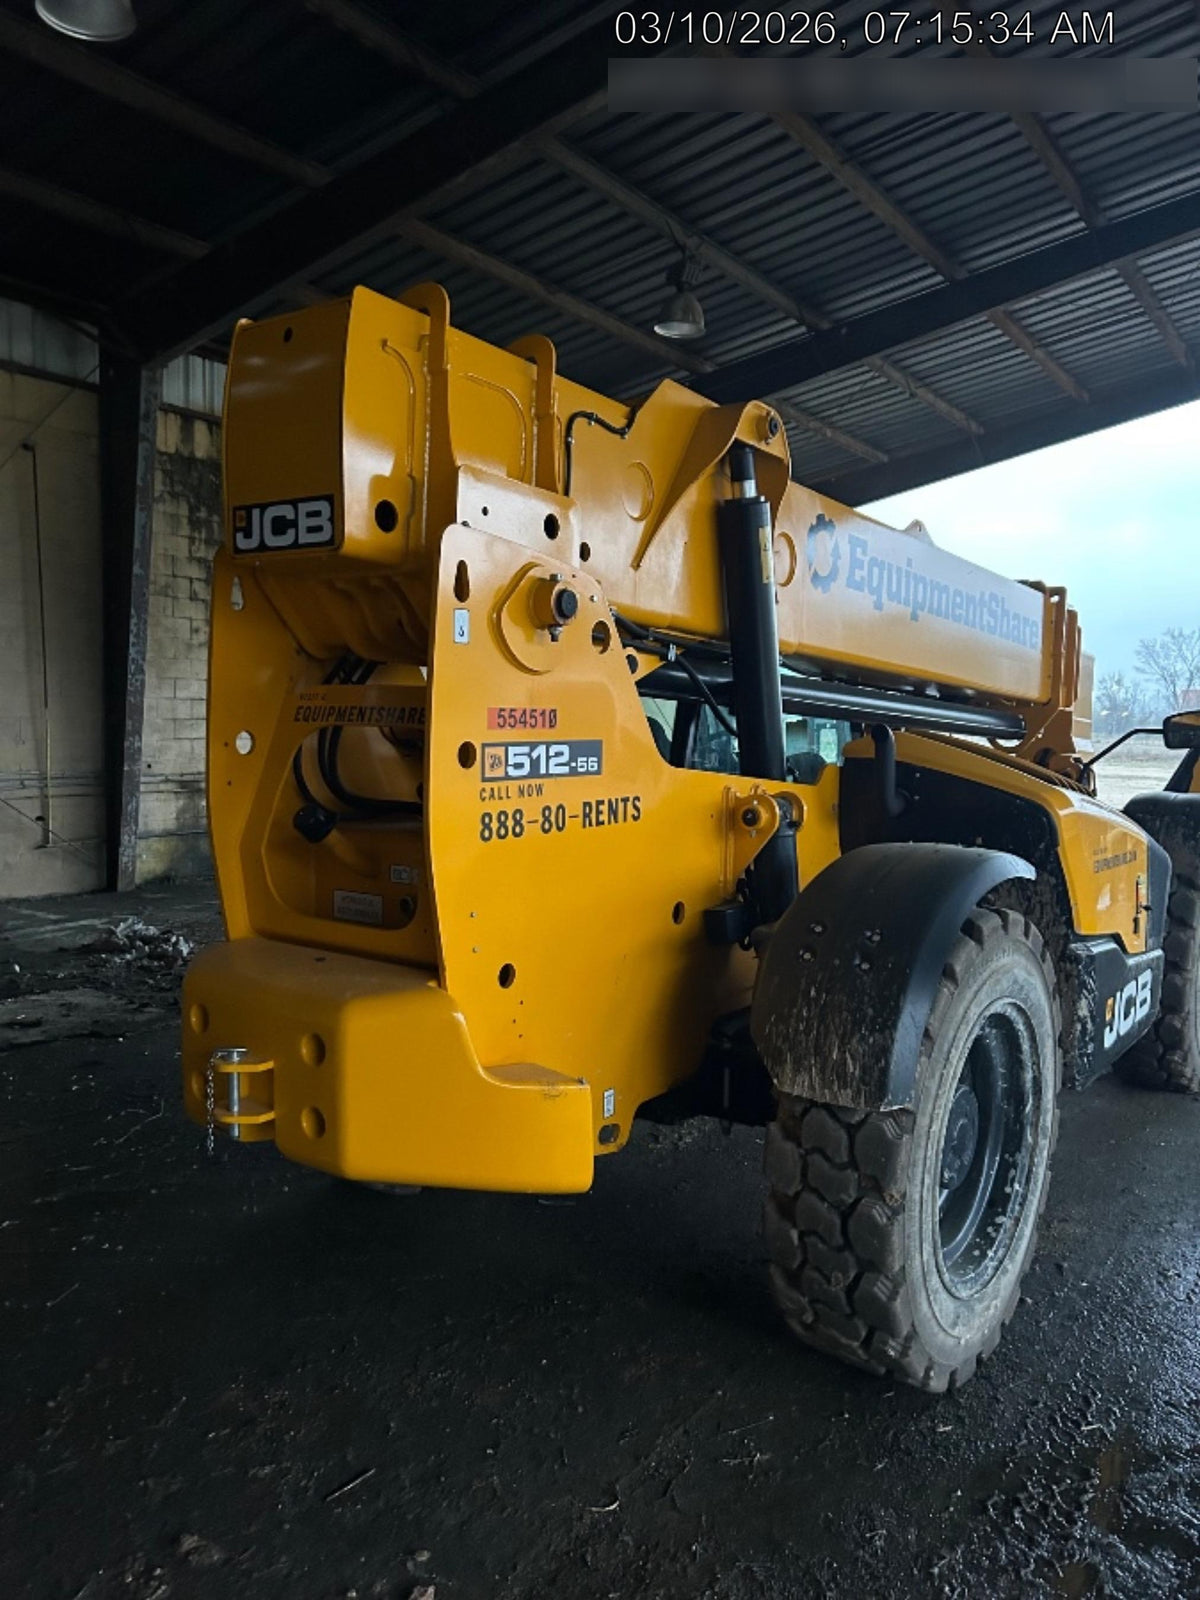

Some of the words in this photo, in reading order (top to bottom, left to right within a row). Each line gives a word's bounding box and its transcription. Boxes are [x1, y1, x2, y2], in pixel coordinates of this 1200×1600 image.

[235, 499, 333, 550] JCB
[845, 532, 1040, 650] EquipmentShare
[496, 707, 558, 729] 554510
[479, 785, 512, 802] CALL
[518, 783, 545, 799] NOW
[479, 795, 642, 843] 888-80-RENTS
[1103, 967, 1153, 1049] JCB
